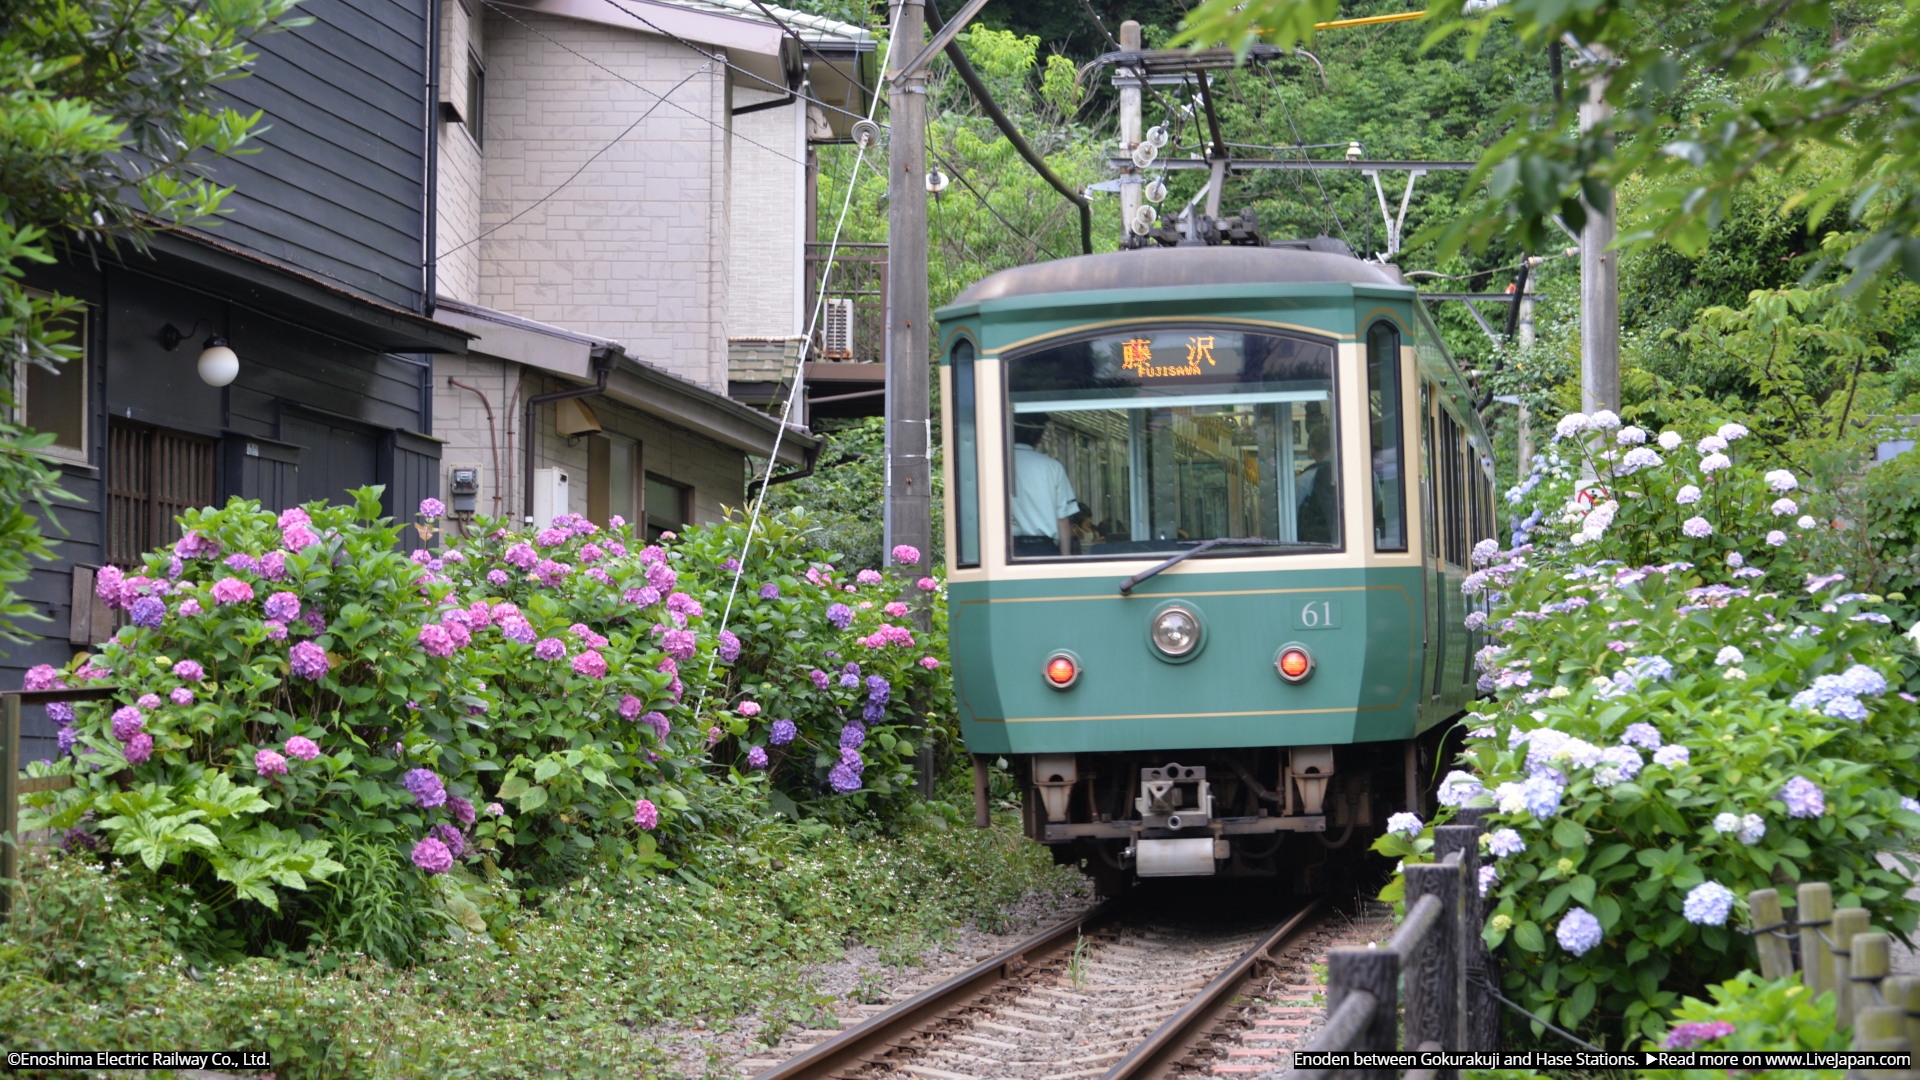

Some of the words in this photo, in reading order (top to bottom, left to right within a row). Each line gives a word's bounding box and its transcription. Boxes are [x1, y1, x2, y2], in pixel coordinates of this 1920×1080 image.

[1121, 335, 1217, 370] 藤沢
[1137, 365, 1202, 378] FUJISAWA
[1301, 600, 1334, 627] 61
